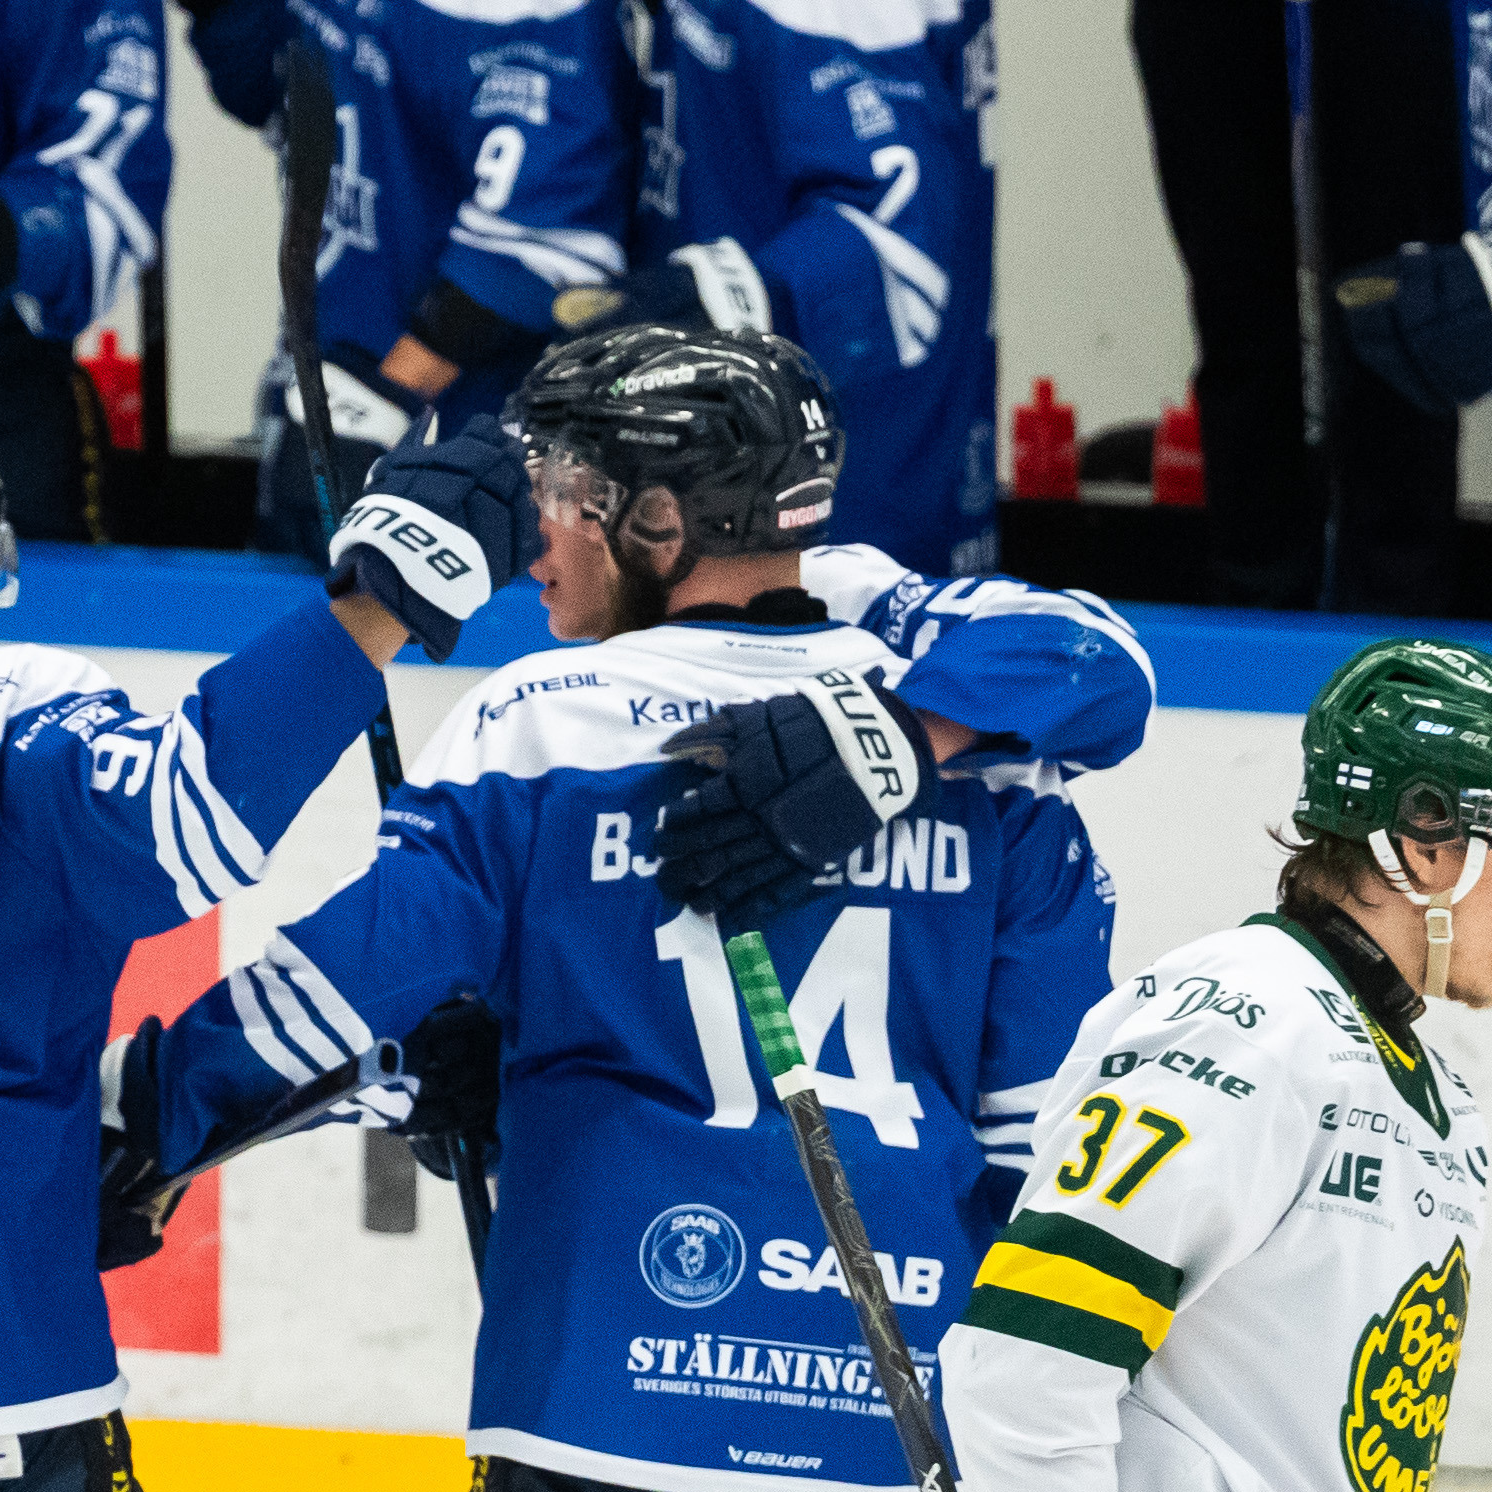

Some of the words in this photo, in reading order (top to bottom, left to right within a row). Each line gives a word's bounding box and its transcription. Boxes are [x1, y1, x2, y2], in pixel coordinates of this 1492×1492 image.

[472, 125, 526, 211] 9
[340, 504, 474, 581] BAU
[814, 667, 905, 799] AUER
[656, 904, 924, 1149] 14
[1163, 976, 1266, 1030] Djös
[1055, 1091, 1193, 1212] 37
[627, 1333, 935, 1402] STÄLLNING.E
[633, 1377, 702, 1396] SVERIGES
[704, 1381, 763, 1402] STÖRSTA
[829, 1398, 896, 1418] STÄLLNIN
[1371, 1364, 1447, 1439] löve
[743, 1447, 822, 1469] BAUER
